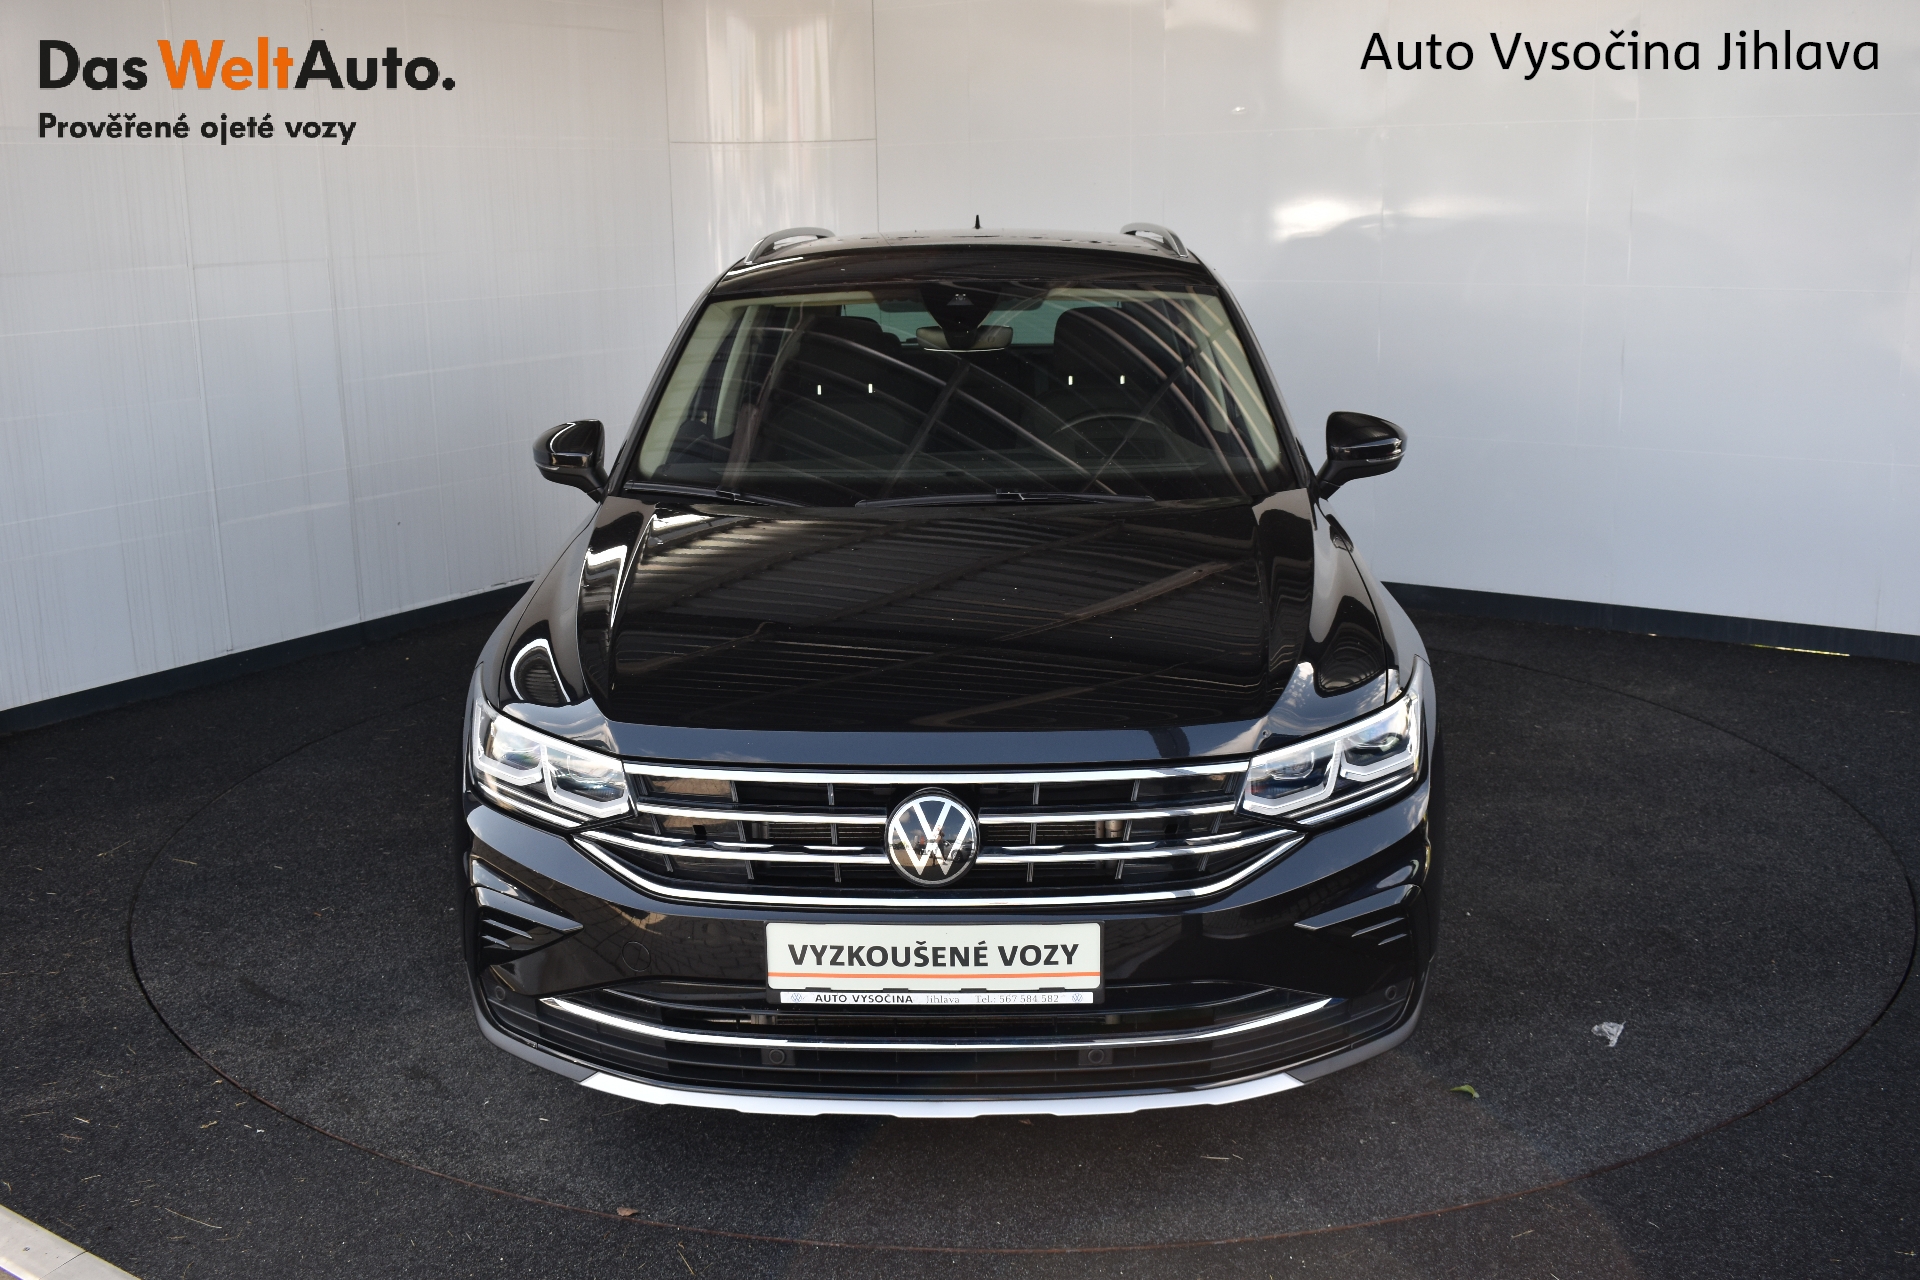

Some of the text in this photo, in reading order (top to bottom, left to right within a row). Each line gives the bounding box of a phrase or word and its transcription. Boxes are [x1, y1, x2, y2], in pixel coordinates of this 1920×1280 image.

[787, 940, 1080, 968] VYZKOUŠENÉ VOZY
[815, 994, 848, 1004] AUTO
[852, 993, 914, 1004] VYSOČINA
[926, 994, 960, 1004] Jihlava
[999, 994, 1018, 1004] 567
[1020, 994, 1038, 1004] 584
[1041, 994, 1060, 1003] 582
